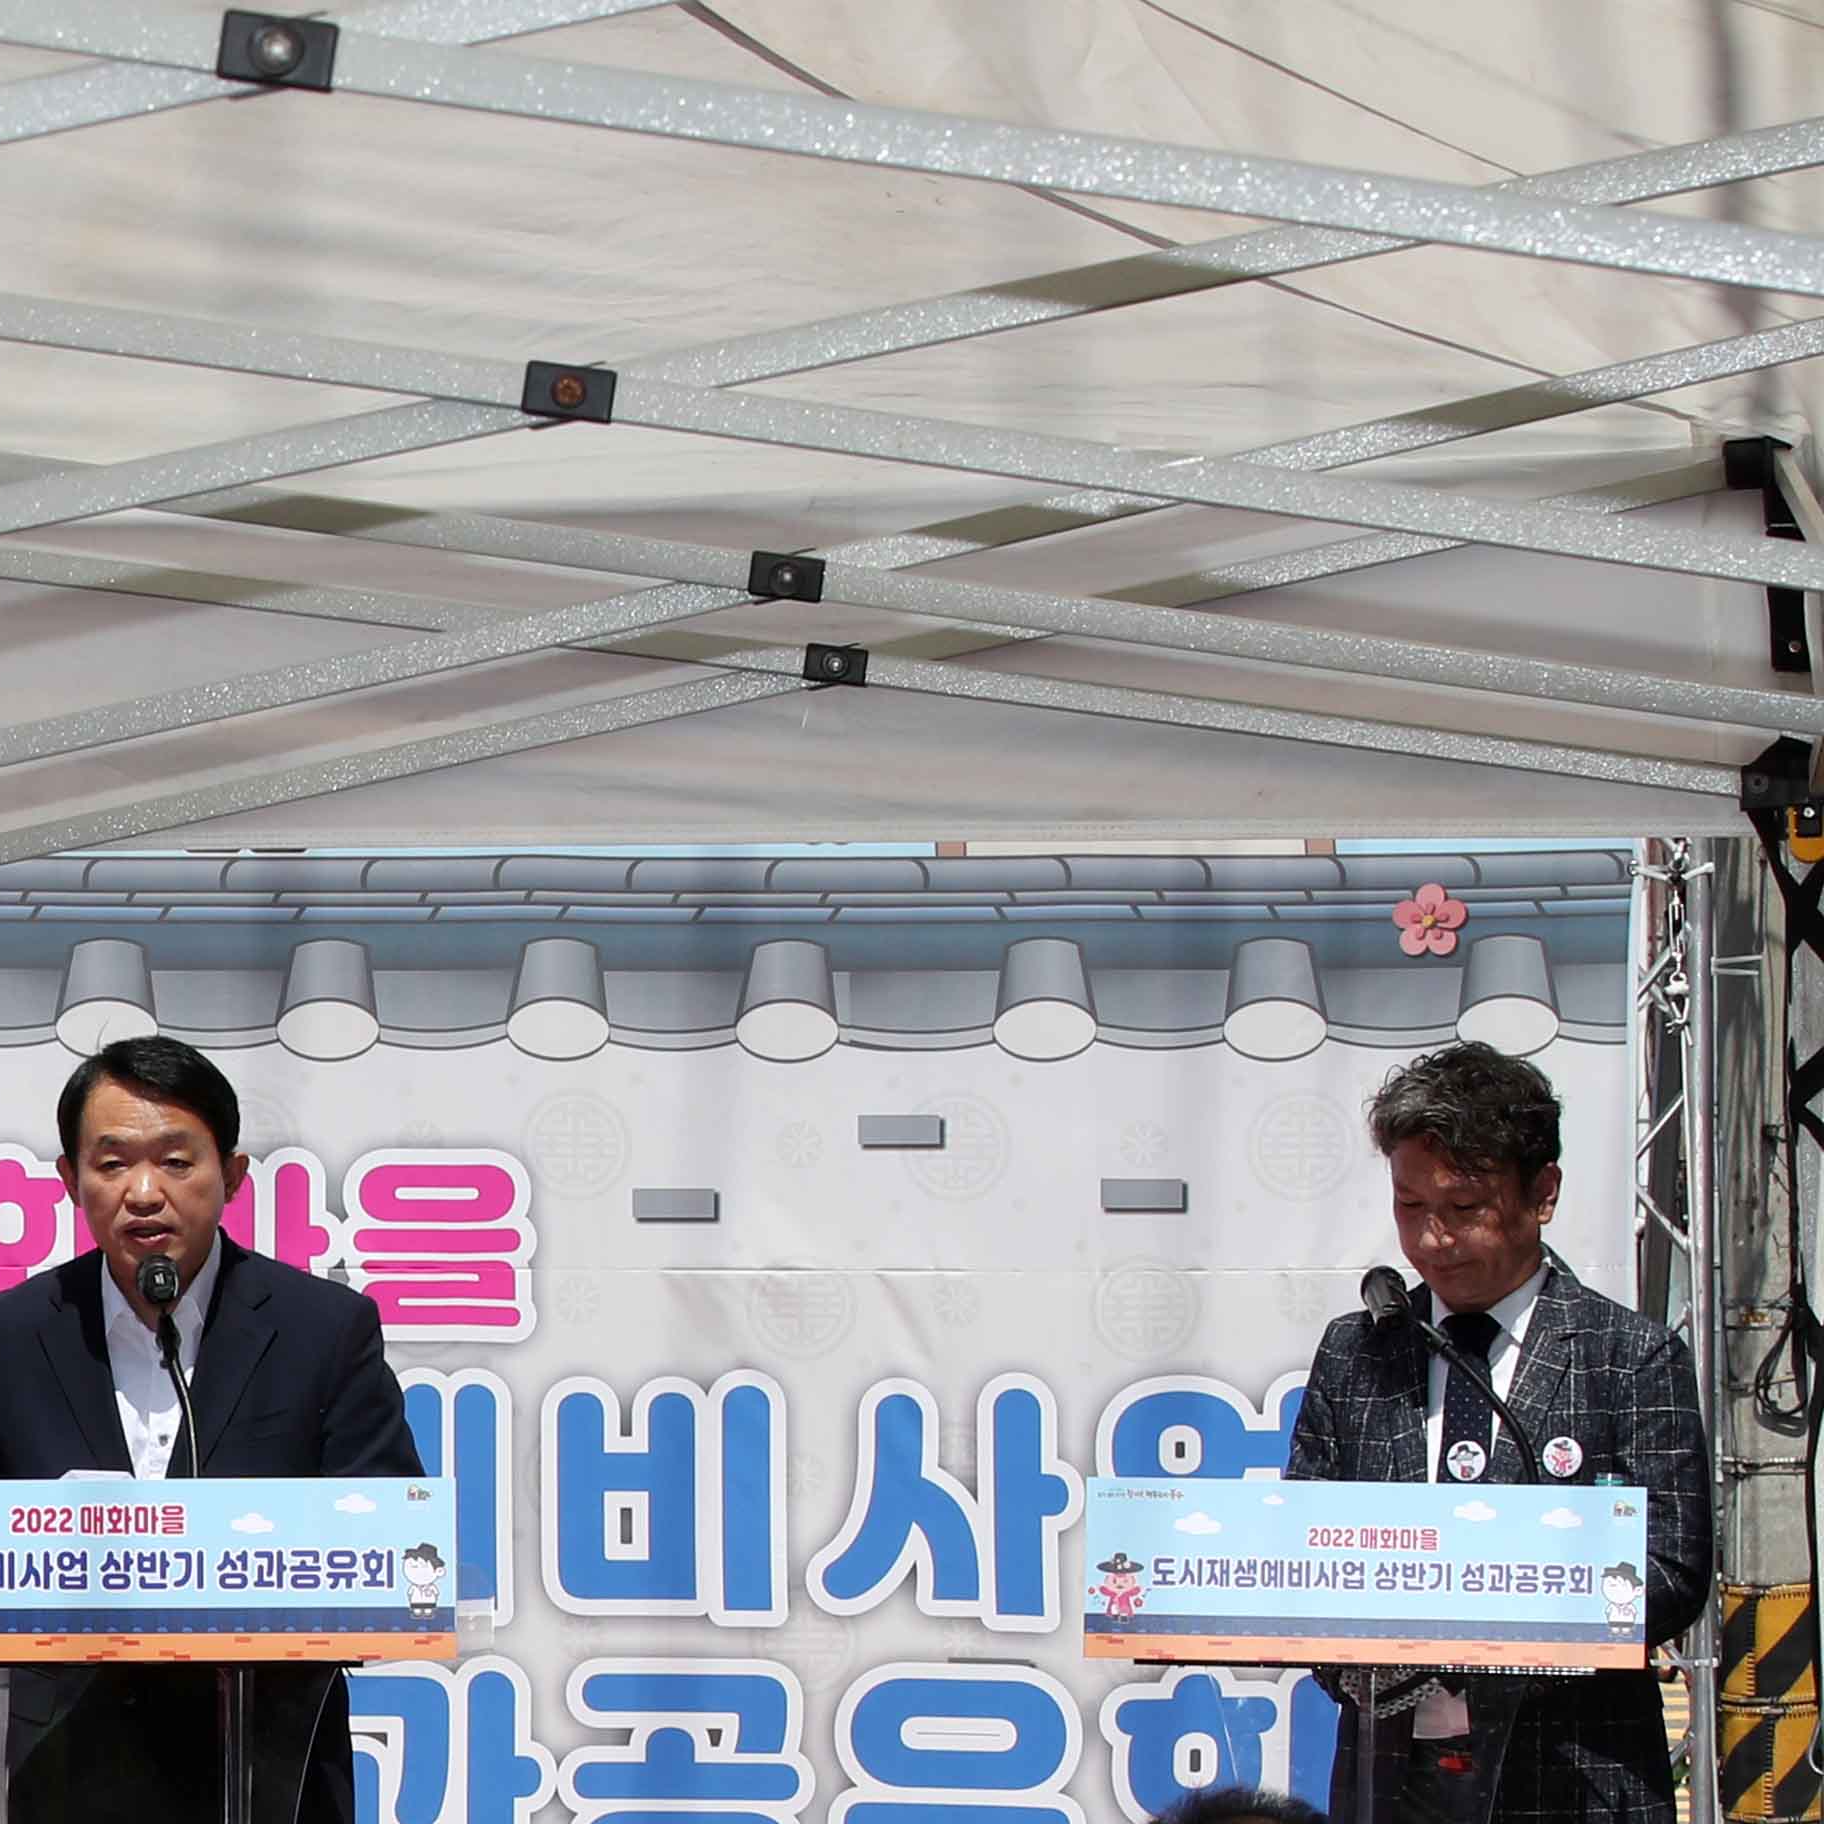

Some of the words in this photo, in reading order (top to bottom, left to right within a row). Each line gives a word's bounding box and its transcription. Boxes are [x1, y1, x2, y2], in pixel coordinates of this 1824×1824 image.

[10, 1505, 74, 1535] 2022
[80, 1503, 186, 1537] 매화마을
[1308, 1527, 1355, 1549] 2022
[1359, 1526, 1439, 1552] 매화마을
[99, 1548, 206, 1591] 상반기
[215, 1547, 396, 1592] 성과공유회
[1150, 1556, 1366, 1592] 도시재생예비사업
[1374, 1559, 1454, 1593] 상반기
[1461, 1561, 1594, 1597] 성과공유회
